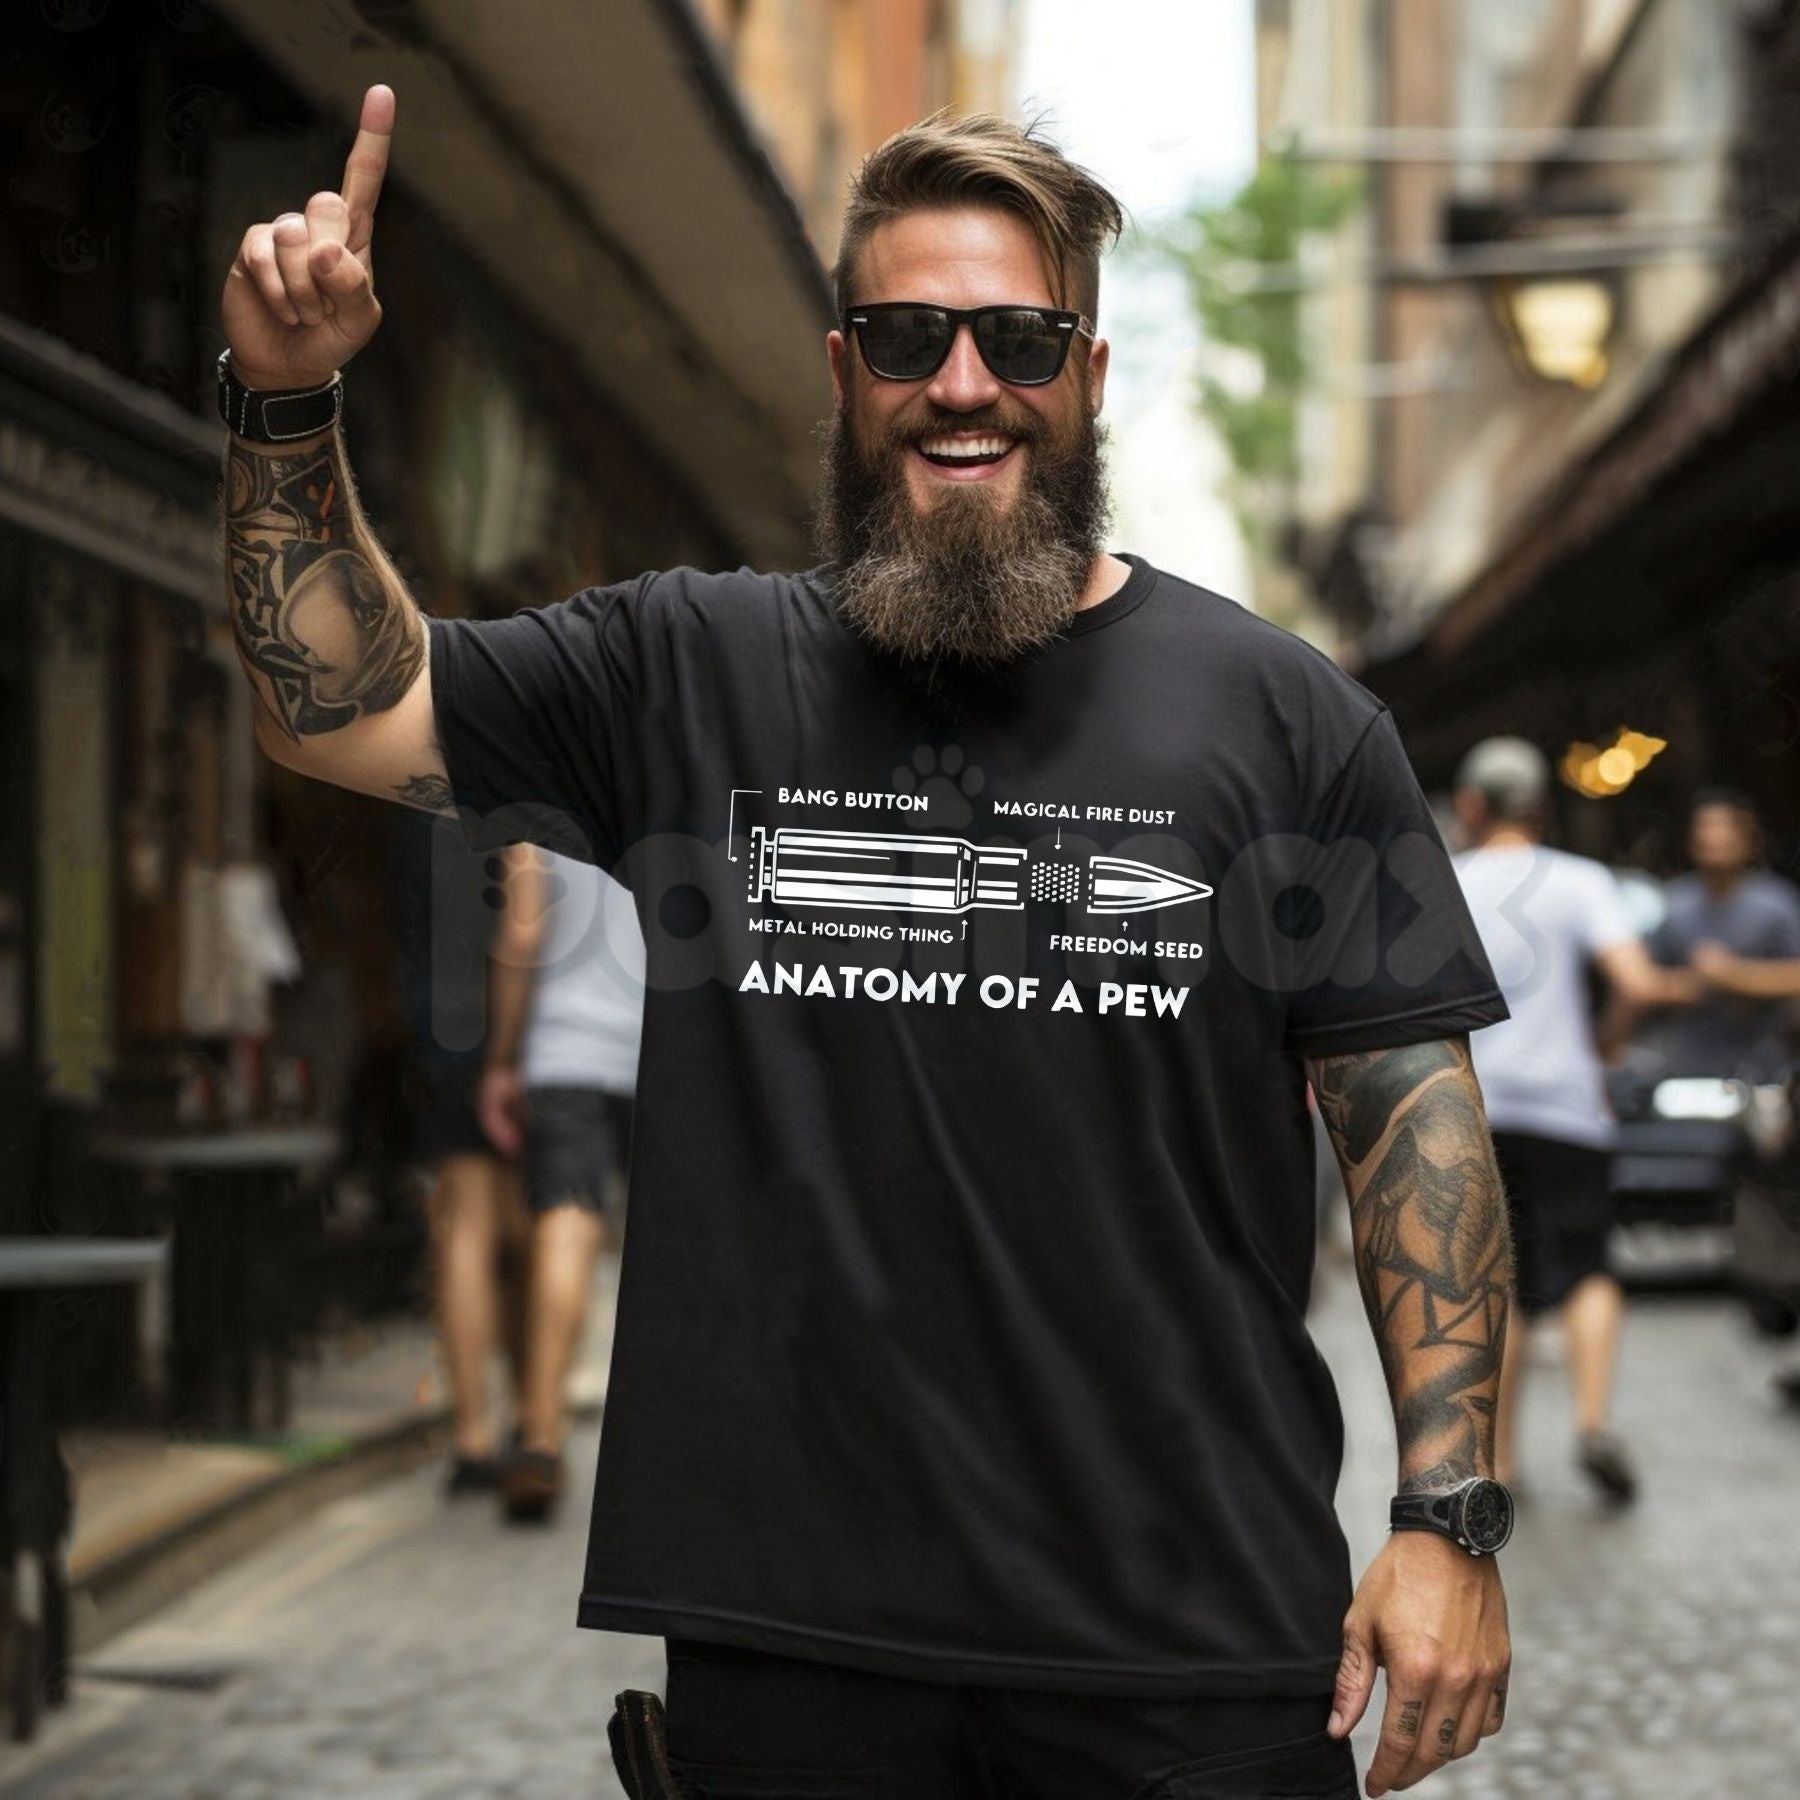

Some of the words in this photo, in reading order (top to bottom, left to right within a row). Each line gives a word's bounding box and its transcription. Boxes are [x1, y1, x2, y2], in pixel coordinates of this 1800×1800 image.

[778, 787, 839, 807] BANG
[844, 791, 929, 812] BUTTON
[993, 800, 1081, 820] MAGICAL
[1086, 806, 1124, 822] FIRE
[1128, 808, 1176, 825] DUST
[748, 917, 807, 935] METAL
[811, 921, 894, 941] HOLDING
[898, 927, 954, 944] THING
[1049, 935, 1148, 956] FREEDOM
[1153, 940, 1203, 960] SEED
[738, 959, 967, 1005] ANATOMY
[979, 974, 1040, 1010] OF
[1050, 979, 1084, 1013] A
[1098, 981, 1191, 1020] PEW
